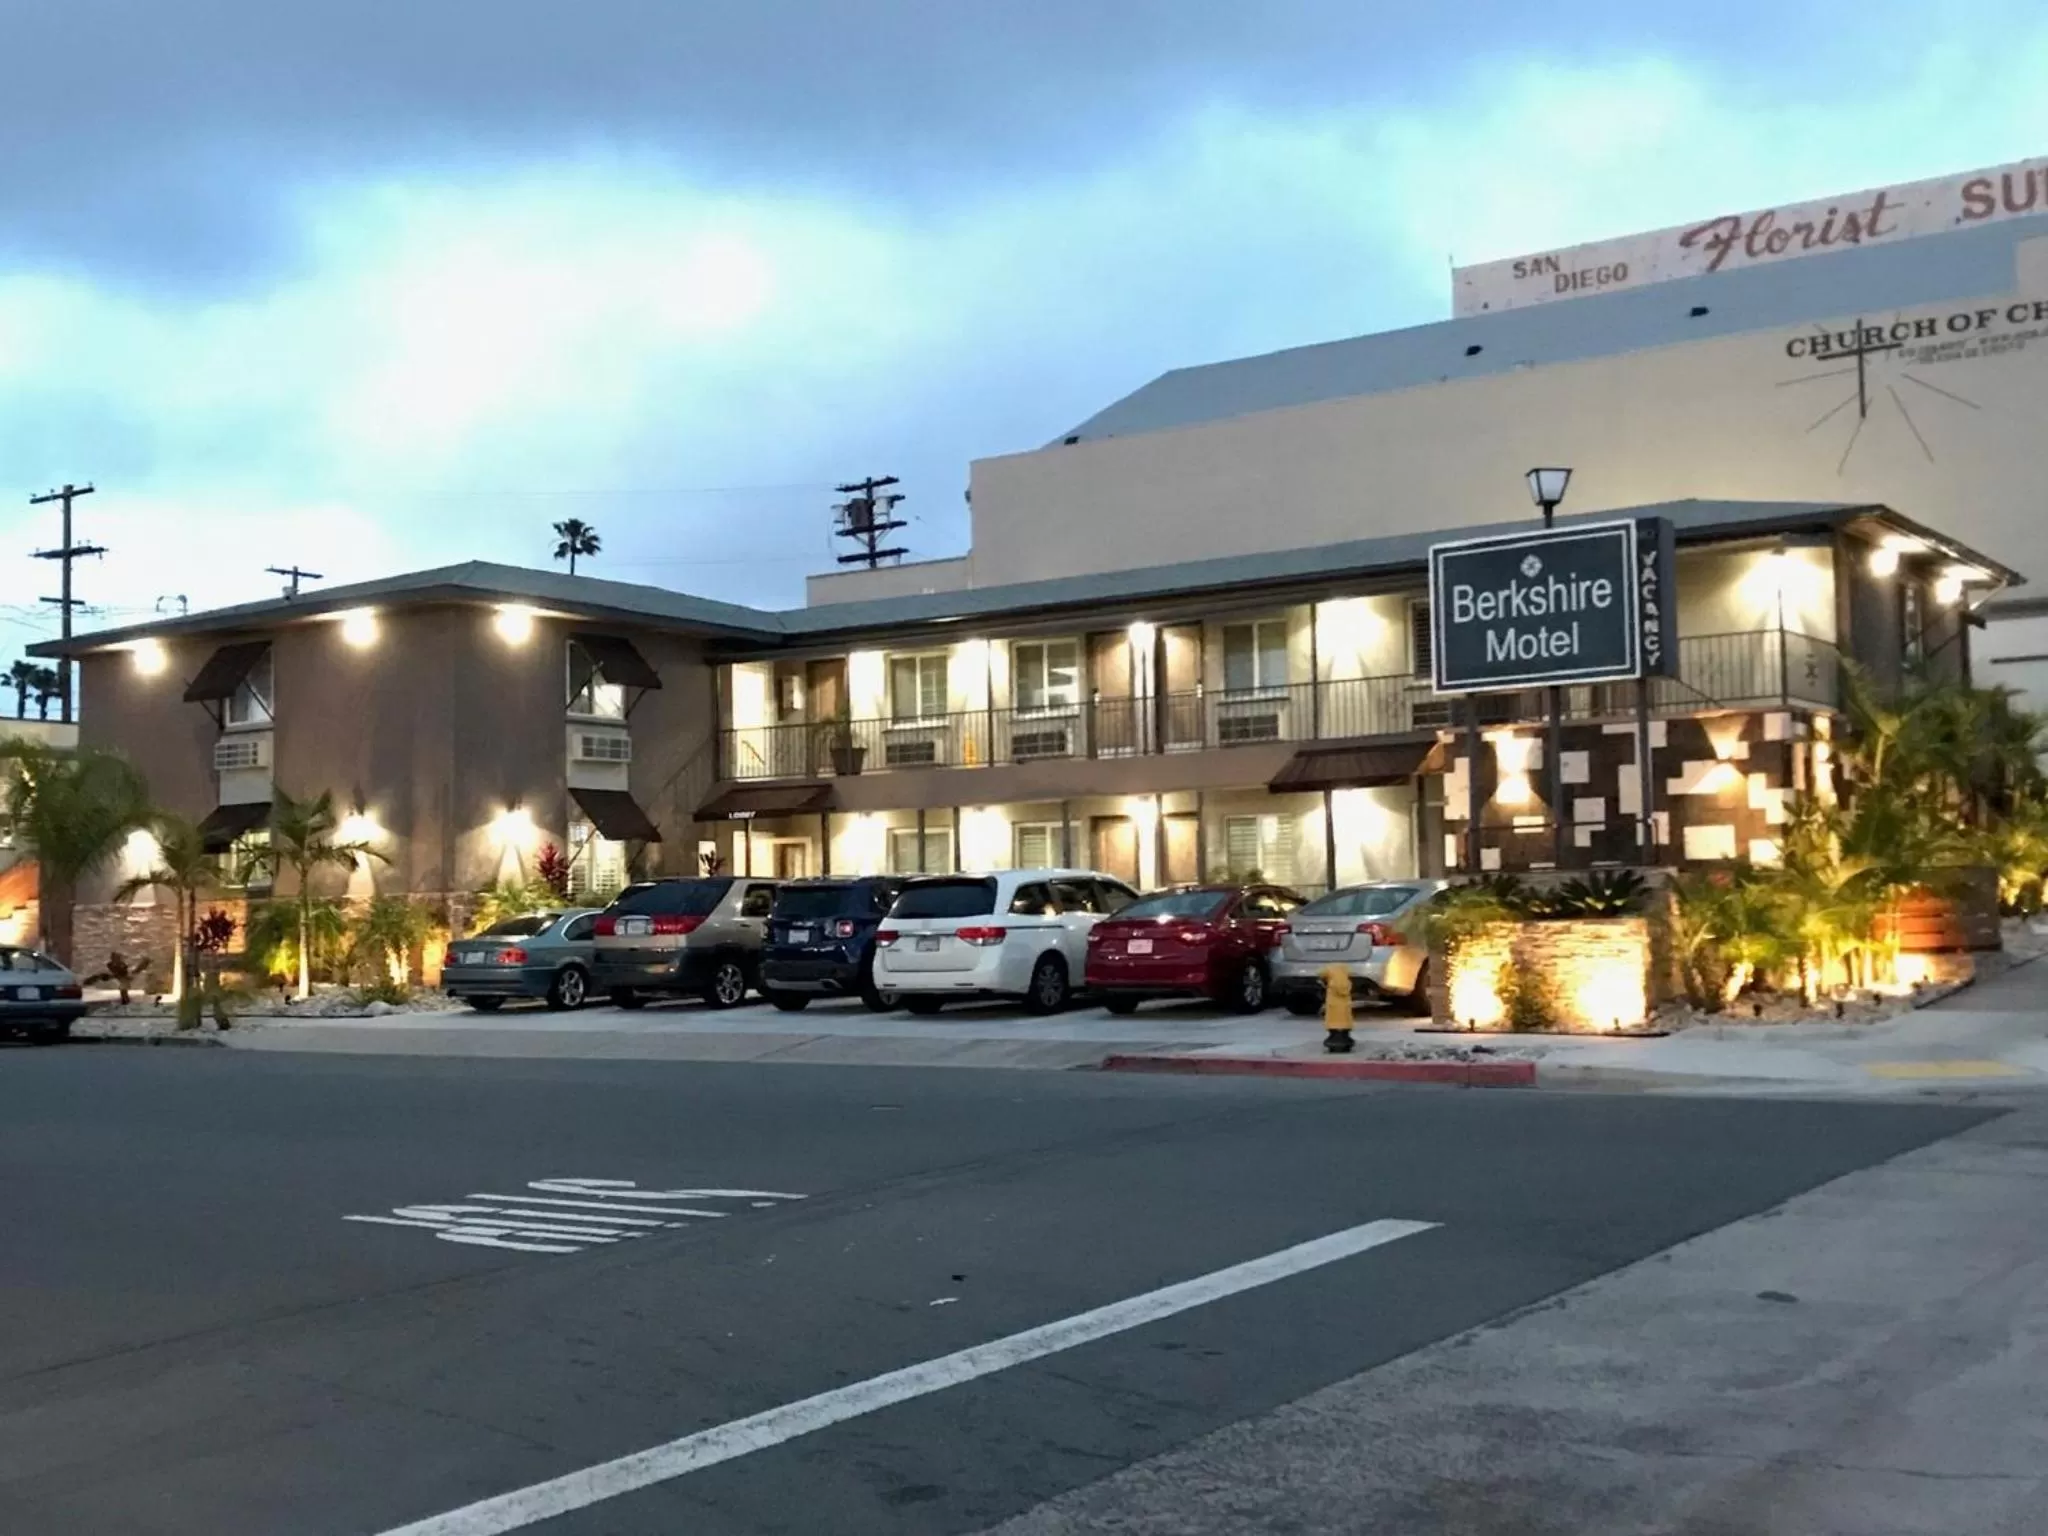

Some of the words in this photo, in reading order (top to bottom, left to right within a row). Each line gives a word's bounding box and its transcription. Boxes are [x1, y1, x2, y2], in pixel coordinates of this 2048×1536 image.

[1960, 164, 2048, 220] SU
[1679, 192, 1905, 273] Florist
[1512, 255, 1561, 279] SAN
[1554, 262, 1630, 294] DIEGO
[1786, 317, 1938, 358] CHURCH
[1946, 307, 1998, 332] OF
[1452, 572, 1613, 624] Berkshire
[1641, 550, 1660, 667] VACANCY
[1486, 621, 1580, 662] Motel
